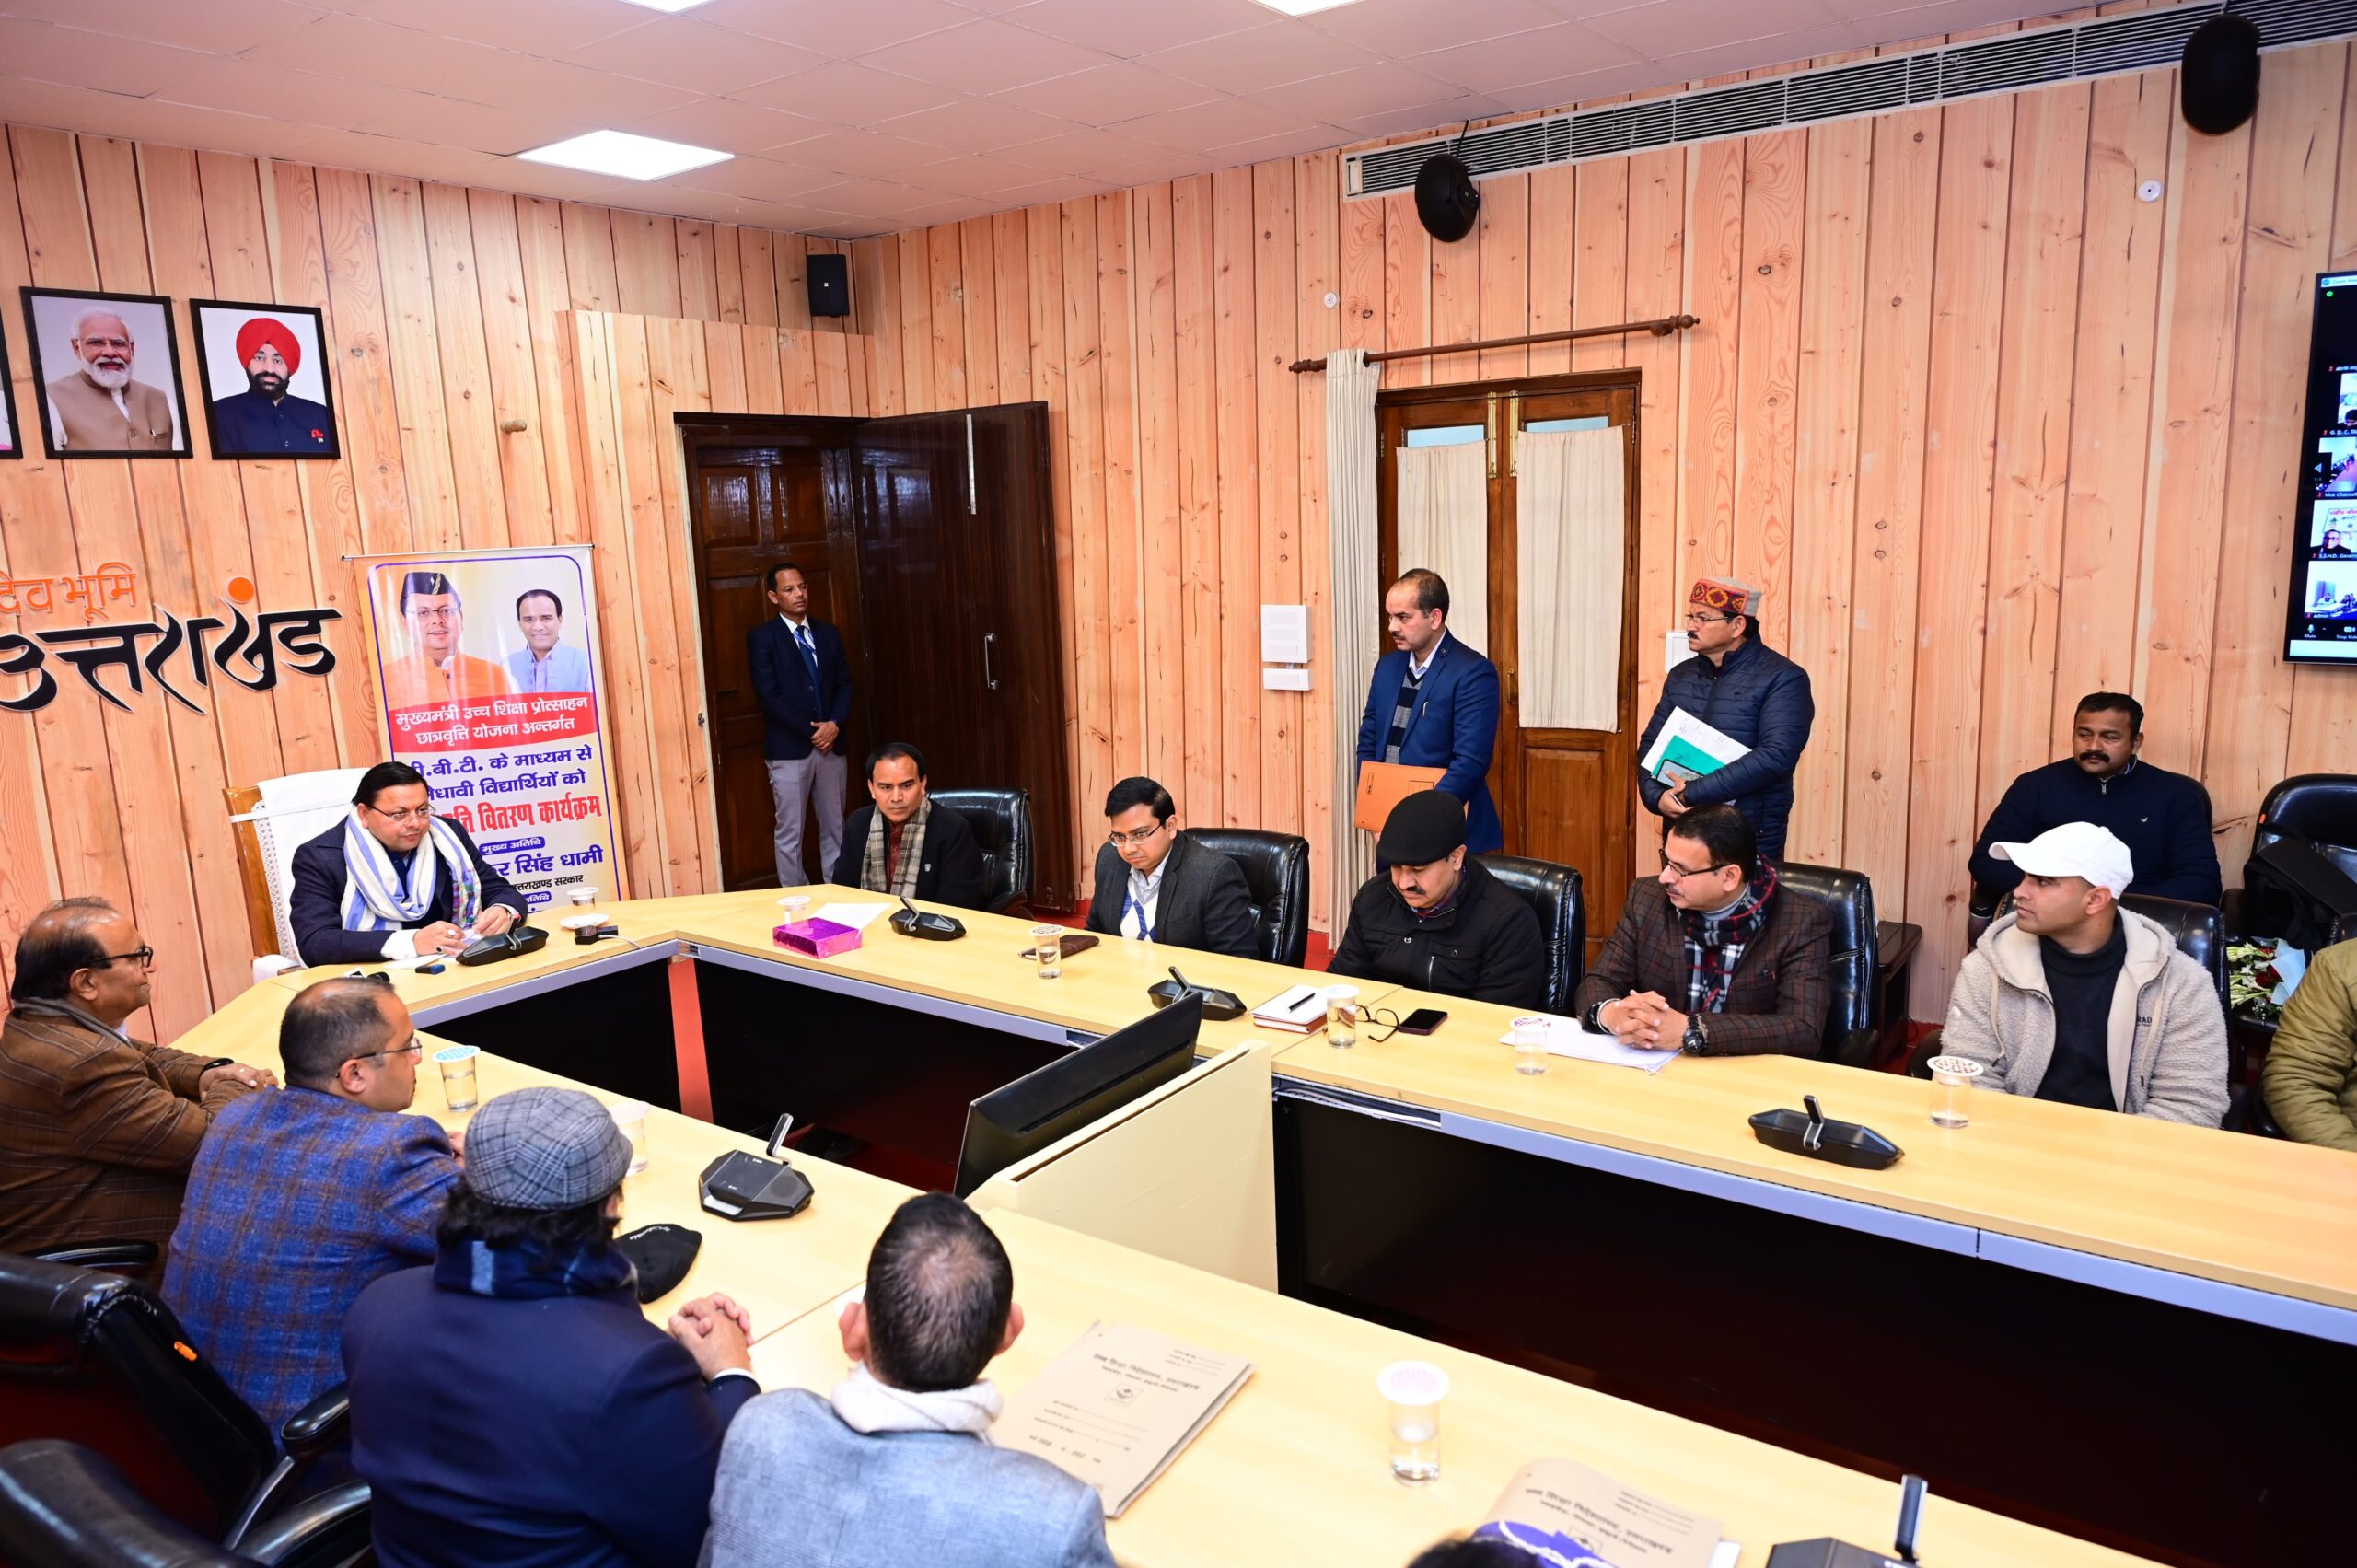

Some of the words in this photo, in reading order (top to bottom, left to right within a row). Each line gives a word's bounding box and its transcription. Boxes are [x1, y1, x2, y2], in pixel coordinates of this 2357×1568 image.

[395, 704, 459, 731] मुख्यमंत्री
[463, 706, 490, 720] उच्च
[493, 700, 528, 716] शिक्षा
[530, 697, 588, 716] प्रोत्साहन
[415, 724, 469, 747] छात्रवृत्ति
[473, 722, 518, 739] योजना
[521, 714, 575, 735] अन्तर्गत
[489, 753, 509, 770] के
[514, 749, 572, 768] माध्यम
[576, 744, 593, 761] से
[479, 771, 560, 796] विद्यार्थियों
[562, 768, 586, 785] को
[478, 802, 535, 831] वितरण
[537, 792, 602, 825] कार्यक्रम
[482, 842, 508, 854] मुख्य
[510, 837, 541, 849] अतिथि
[514, 853, 554, 874] सिंह
[560, 844, 604, 866] धामी
[514, 878, 552, 891] त्तराखण्ड
[554, 875, 584, 886] सरकार
